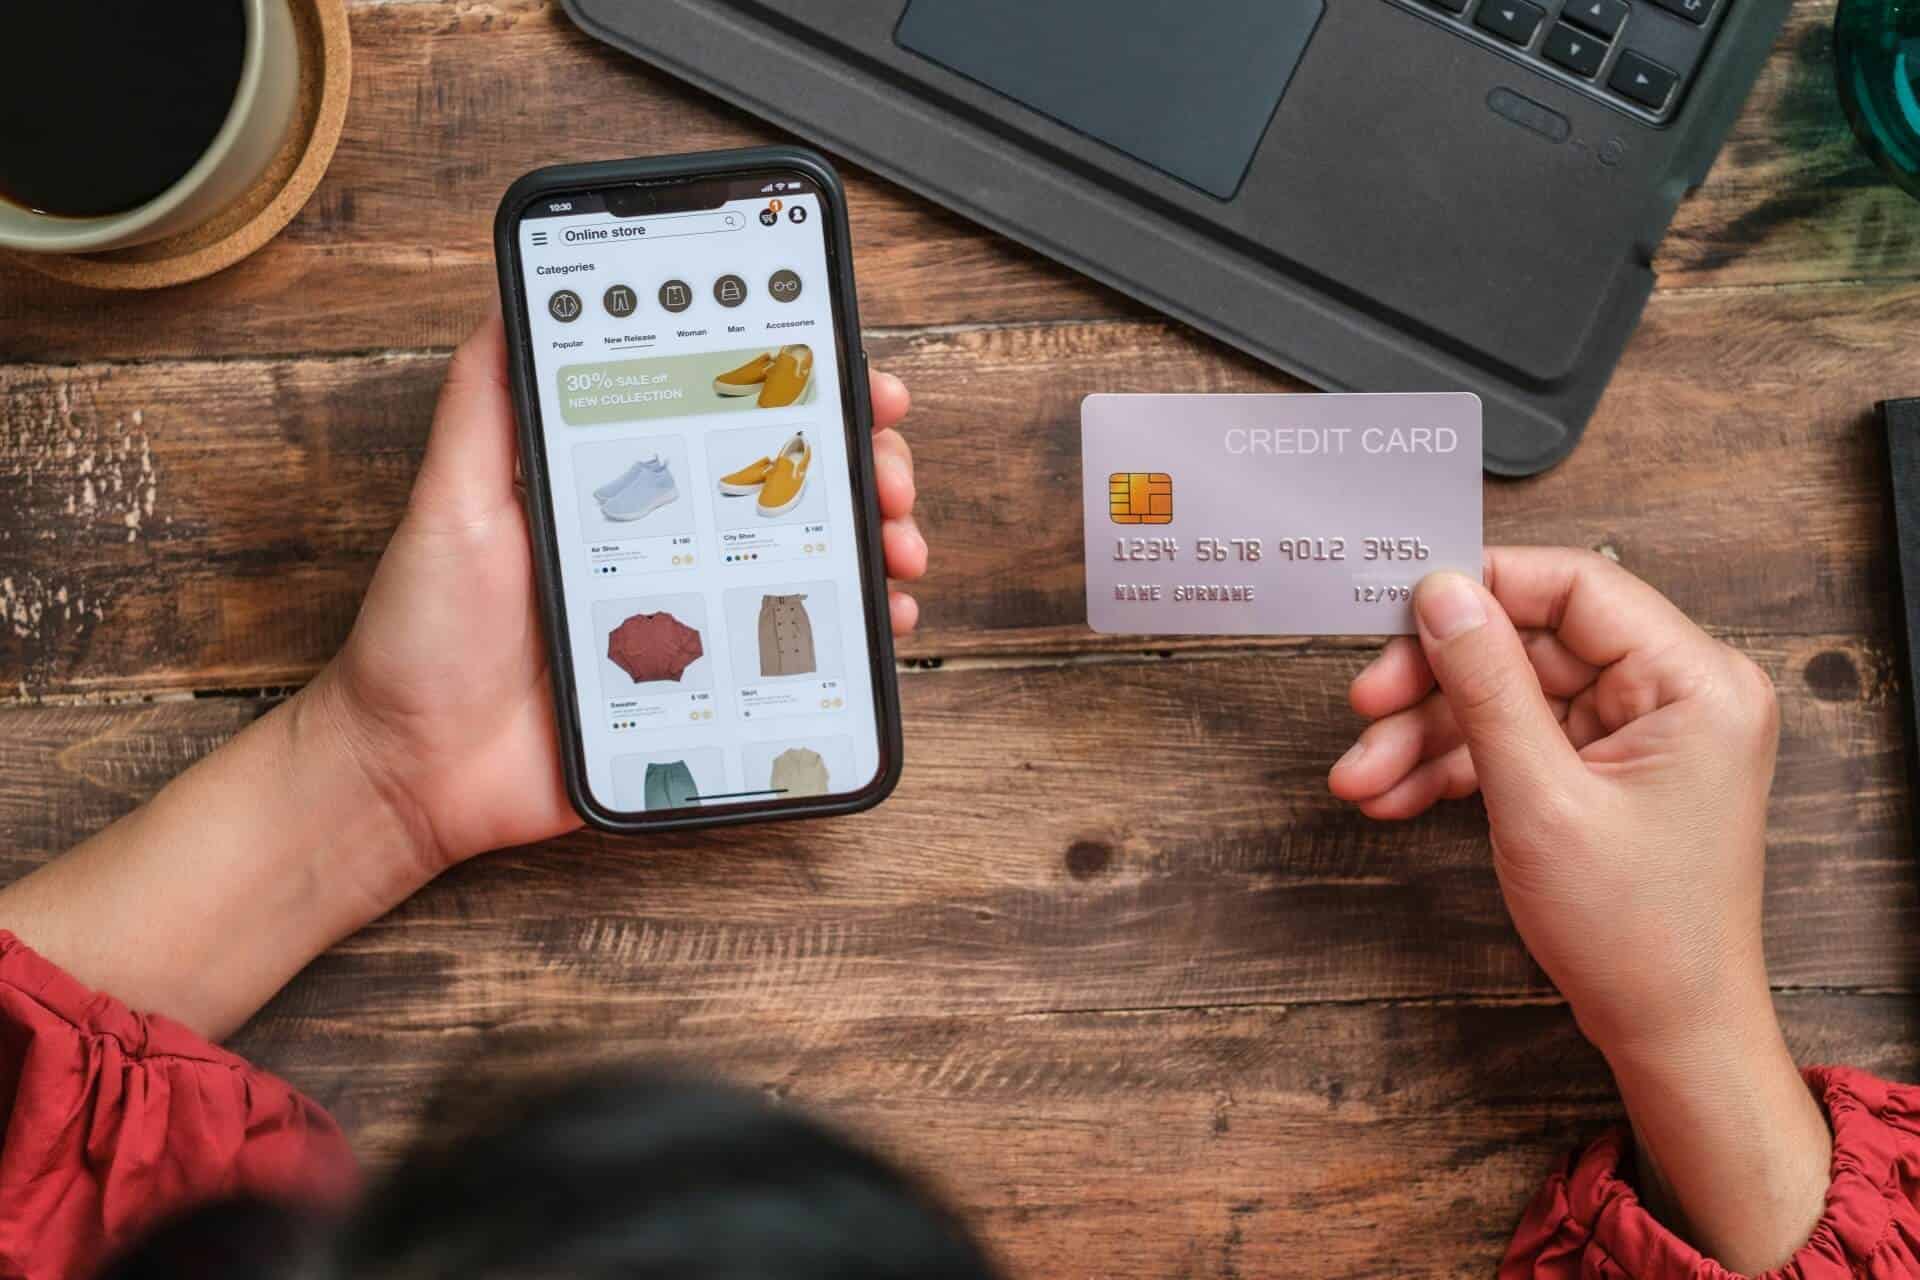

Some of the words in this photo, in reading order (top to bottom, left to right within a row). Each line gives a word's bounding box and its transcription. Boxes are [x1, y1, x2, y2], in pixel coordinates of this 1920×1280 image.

[565, 228, 608, 242] Online
[611, 225, 646, 238] store
[536, 262, 595, 276] Categories
[727, 325, 745, 333] Man
[766, 319, 815, 329] Accessories
[624, 334, 656, 343] Release
[677, 329, 707, 338] Woman
[552, 340, 584, 350] Popular
[566, 370, 613, 392] 30%
[616, 375, 649, 386] SALE
[651, 373, 669, 384] off
[568, 397, 598, 409] NEW
[601, 388, 683, 405] COLLECTION
[1225, 427, 1351, 455] CREDIT
[1361, 426, 1457, 454] CARD
[1113, 537, 1179, 562] 1234
[1195, 537, 1263, 562] 5678
[1279, 537, 1345, 562] 9012
[1362, 536, 1430, 561] 3456
[1114, 584, 1161, 601] NAME
[1174, 584, 1255, 602] SURNAME
[1354, 586, 1410, 603] 12/99
